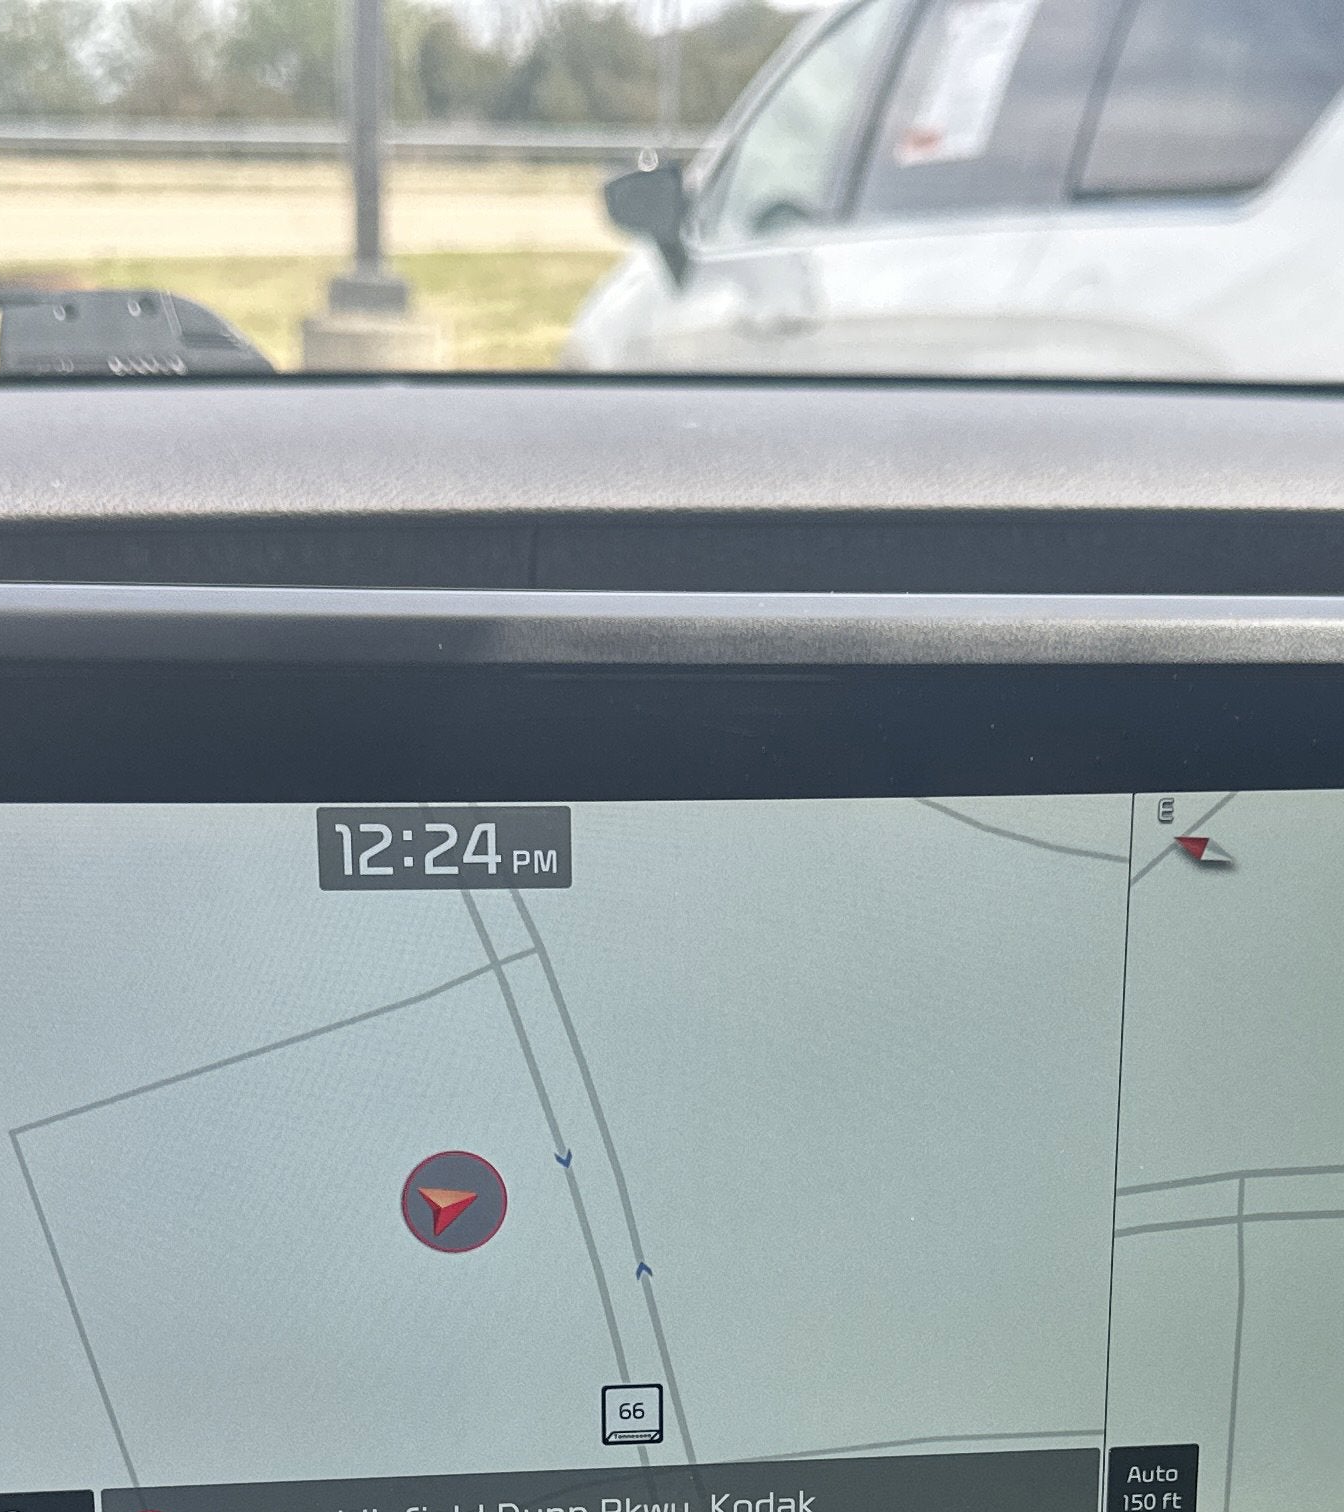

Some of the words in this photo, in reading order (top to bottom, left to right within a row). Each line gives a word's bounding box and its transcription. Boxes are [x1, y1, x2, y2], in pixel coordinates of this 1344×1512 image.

[1158, 797, 1174, 824] E
[335, 822, 502, 876] 12:24
[512, 849, 557, 874] PM
[619, 1402, 645, 1419] 66
[1126, 1465, 1178, 1483] Auto
[1123, 1493, 1156, 1511] 150
[1162, 1492, 1182, 1510] ft
